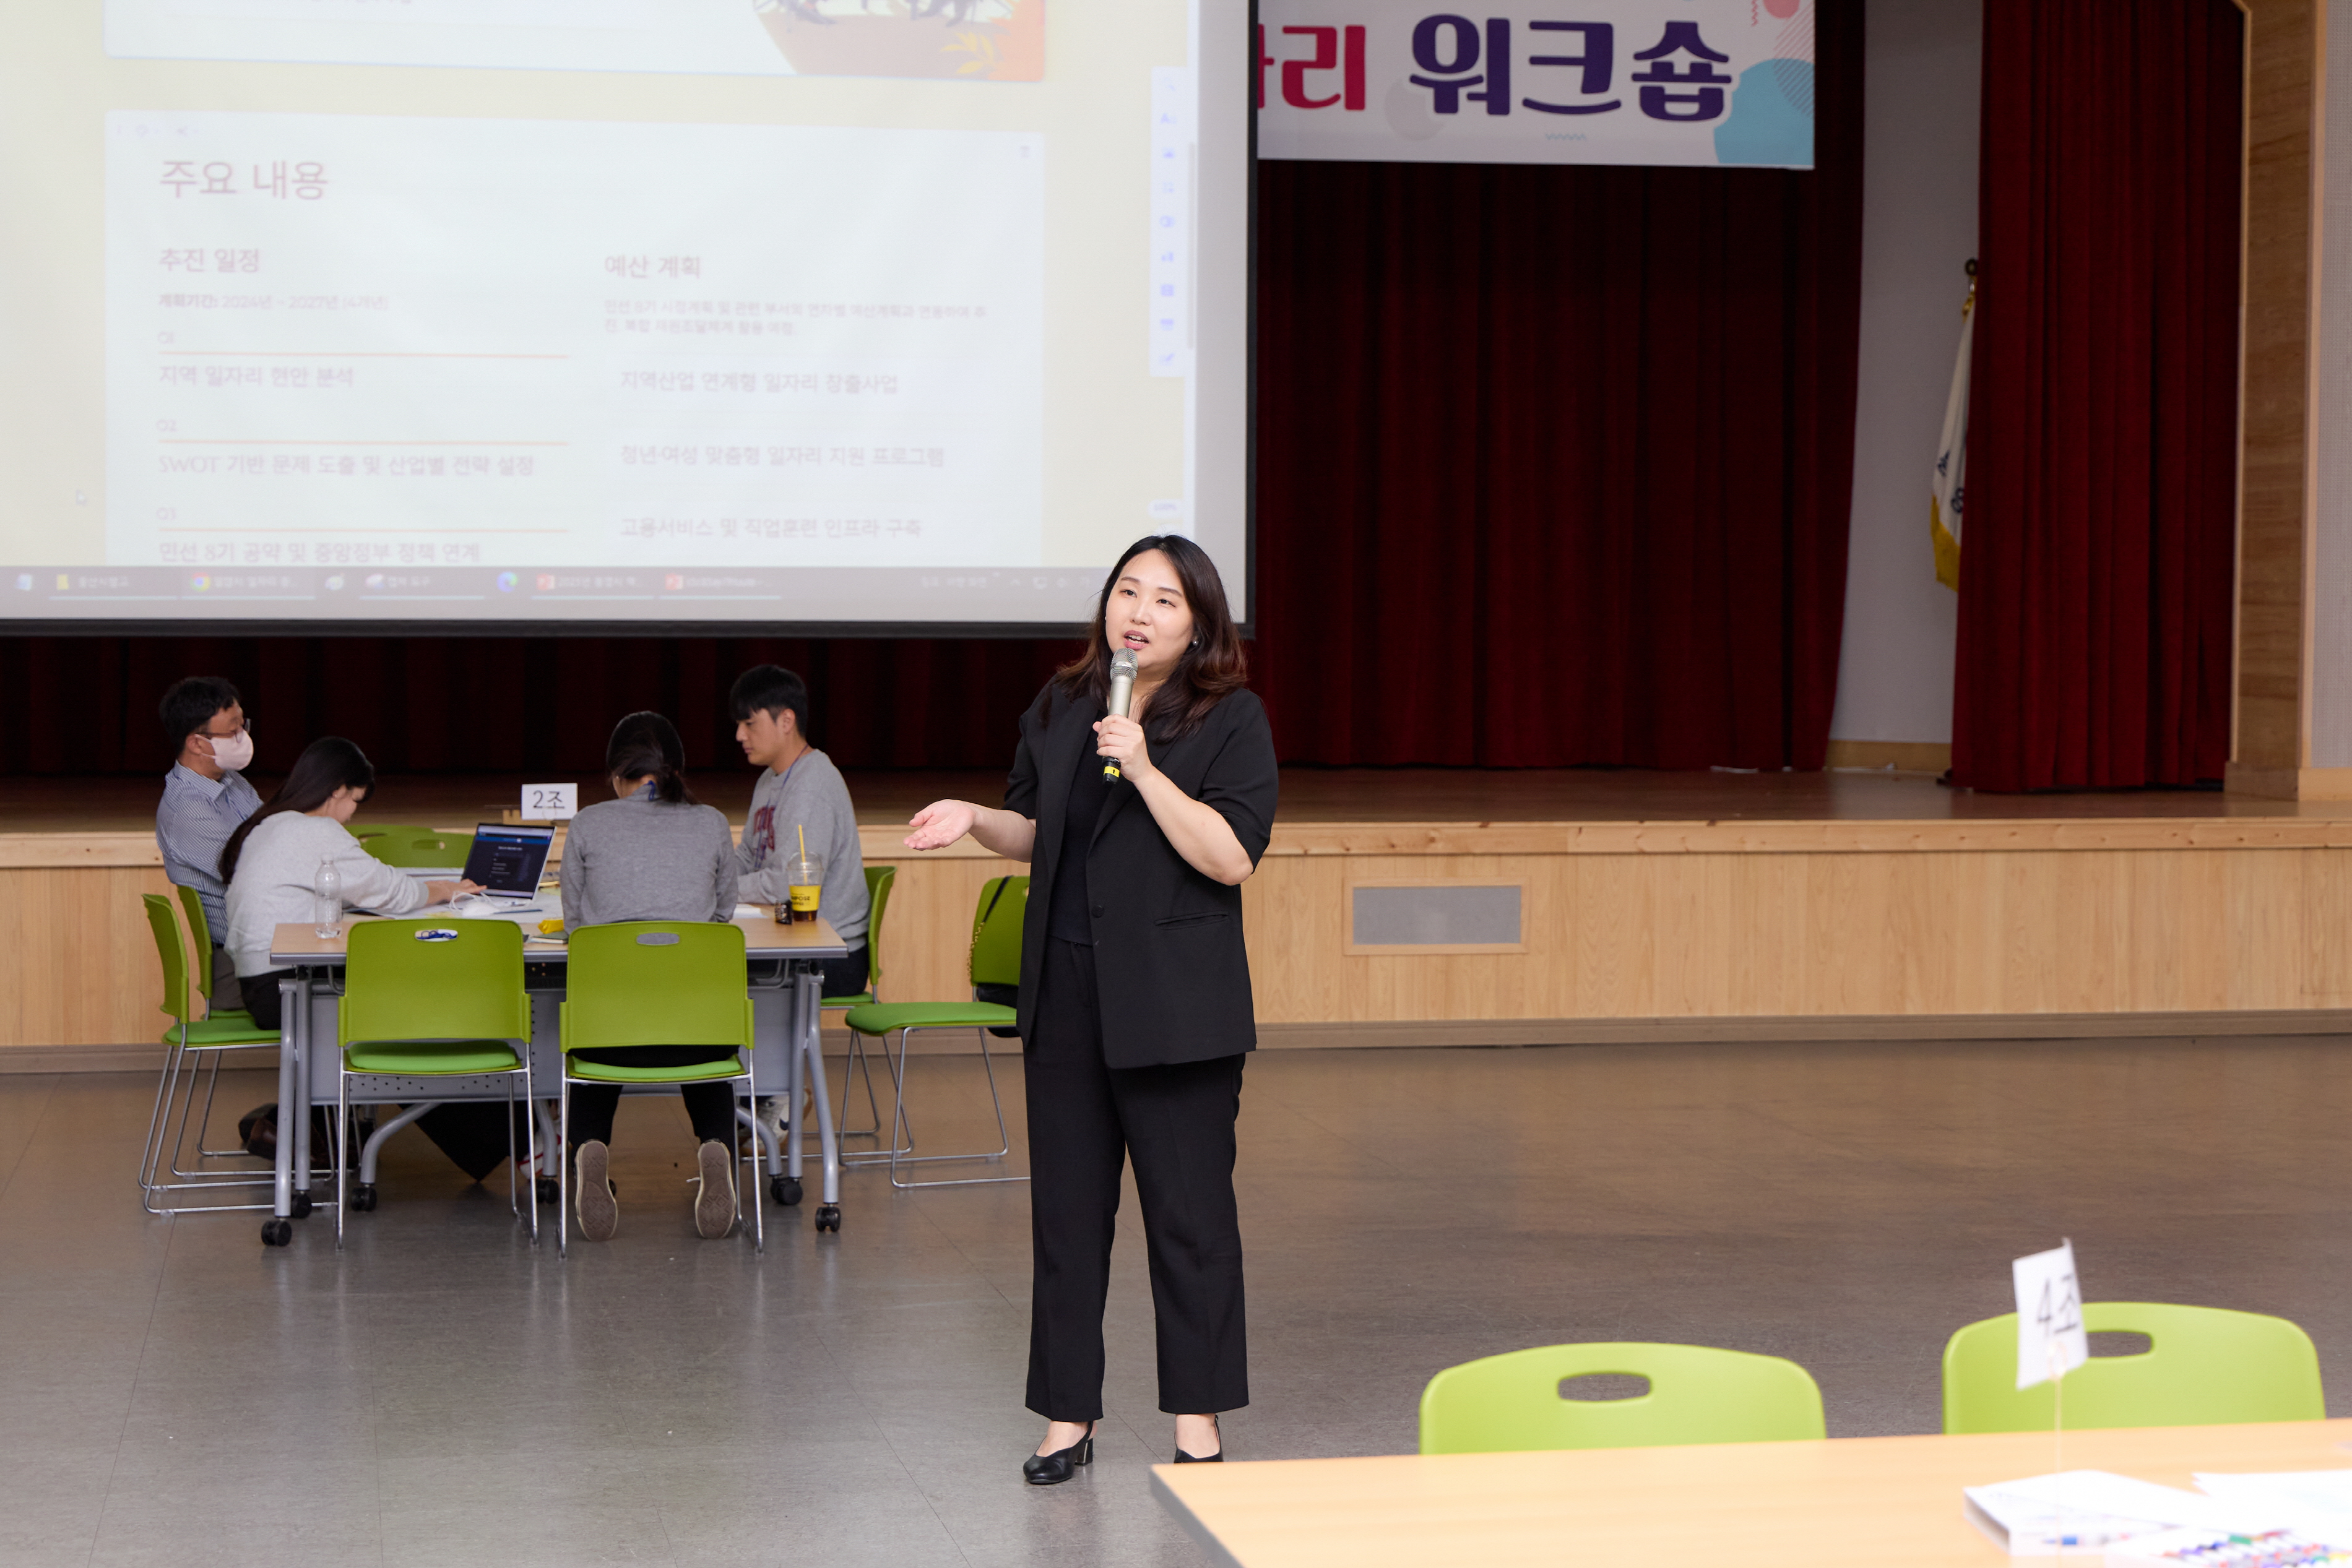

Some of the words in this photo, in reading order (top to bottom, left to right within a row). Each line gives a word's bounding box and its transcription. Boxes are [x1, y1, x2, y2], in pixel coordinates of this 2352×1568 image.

[1409, 14, 1733, 122] 워크숍
[158, 158, 238, 199] 주요
[251, 158, 330, 201] 내용
[158, 247, 205, 273] 추진
[213, 247, 260, 274] 일정
[603, 254, 649, 279] 예산
[657, 254, 701, 279] 계획
[158, 293, 218, 310] 계획기간:
[222, 294, 272, 309] 2024년
[288, 295, 339, 311] 2027년
[159, 364, 198, 386] 지역
[204, 364, 263, 387] 일자리
[270, 365, 310, 388] 현안
[314, 366, 355, 388] 분석
[621, 371, 696, 392] 지역산업
[701, 371, 758, 394] 연계형
[763, 373, 819, 394] 일자리
[825, 373, 899, 395] 창출사업
[155, 417, 178, 433] 02
[158, 455, 219, 474] SWOT
[227, 454, 266, 475] 기반
[272, 454, 311, 475] 문제
[317, 454, 357, 476] 도출
[361, 454, 381, 476] 및
[387, 454, 446, 477] 산업별
[452, 455, 492, 476] 전략
[496, 455, 535, 477] 설정
[704, 445, 761, 467] 맞춤형
[767, 446, 823, 467] 일자리
[828, 446, 867, 468] 지원
[871, 446, 946, 468] 프로그램
[155, 506, 178, 522] 03
[620, 517, 714, 538] 고용서비스
[719, 517, 738, 538] 및
[744, 518, 818, 539] 직업훈련
[824, 518, 881, 539] 인프라
[885, 518, 923, 538] 구축
[159, 541, 198, 562] 민선
[204, 541, 236, 562] 8기
[243, 542, 282, 563] 공약
[287, 542, 307, 563] 및
[314, 541, 391, 564] 중앙정부
[397, 542, 436, 563] 정책
[441, 542, 481, 563] 연계
[532, 789, 565, 809] 2조
[2036, 1272, 2080, 1338] 4조
